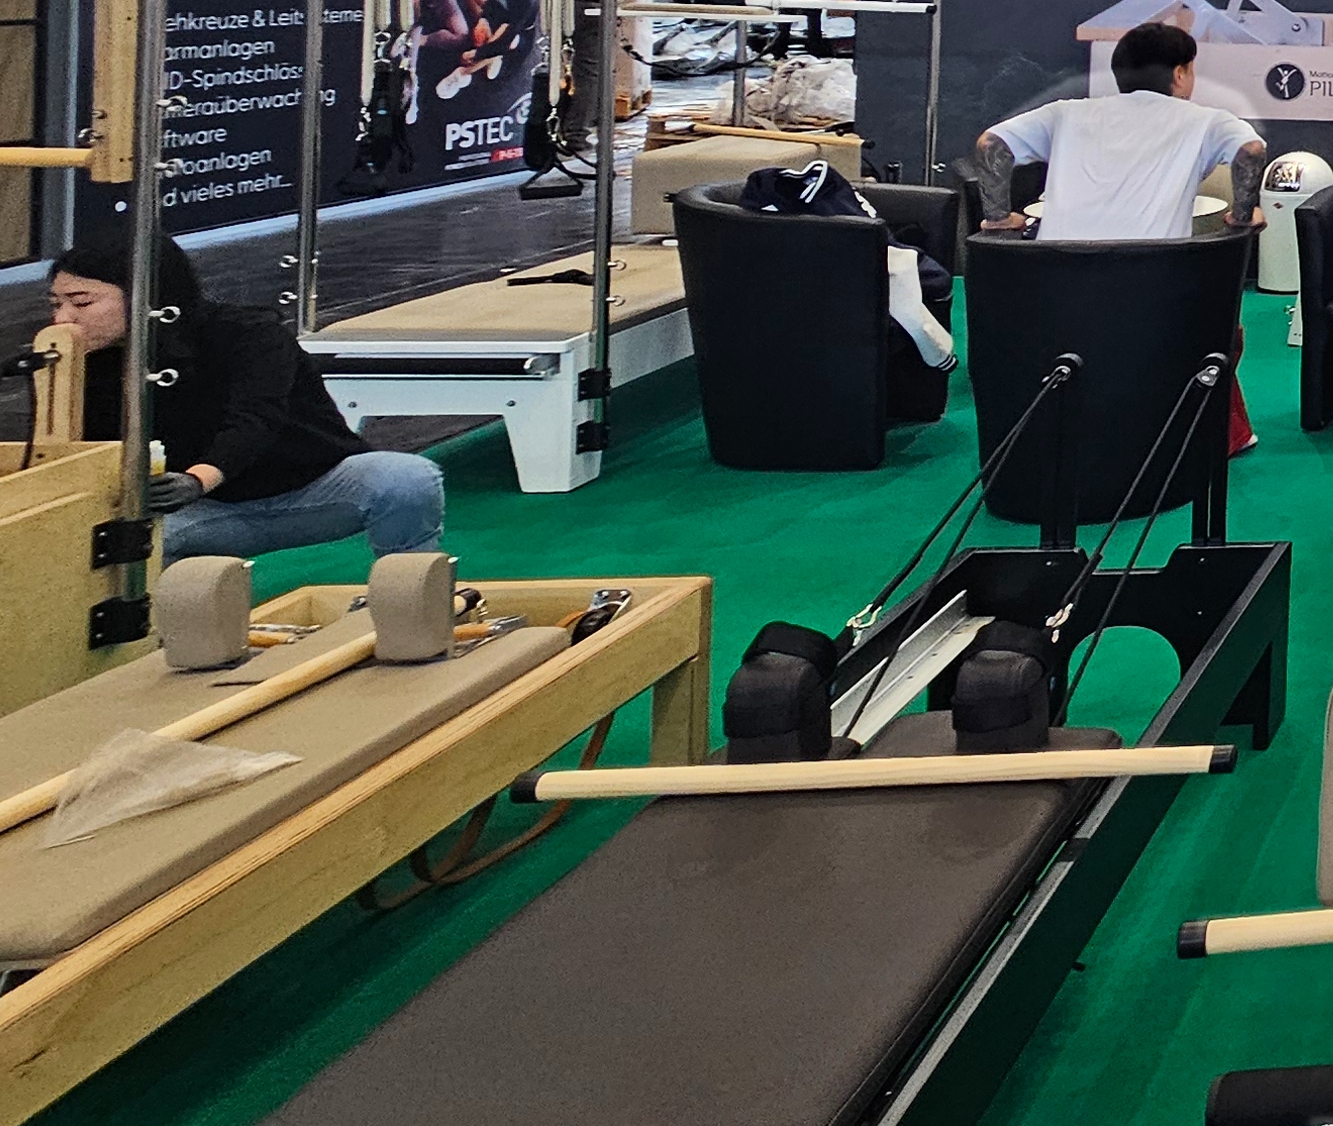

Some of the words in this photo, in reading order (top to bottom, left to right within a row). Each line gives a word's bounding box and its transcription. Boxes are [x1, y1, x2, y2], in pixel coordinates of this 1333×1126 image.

[165, 12, 249, 32] ehkreuze
[252, 10, 266, 27] &
[164, 39, 276, 61] armanlagen
[163, 127, 228, 149] ftware
[445, 115, 514, 151] PSTEC
[180, 182, 234, 204] vieles
